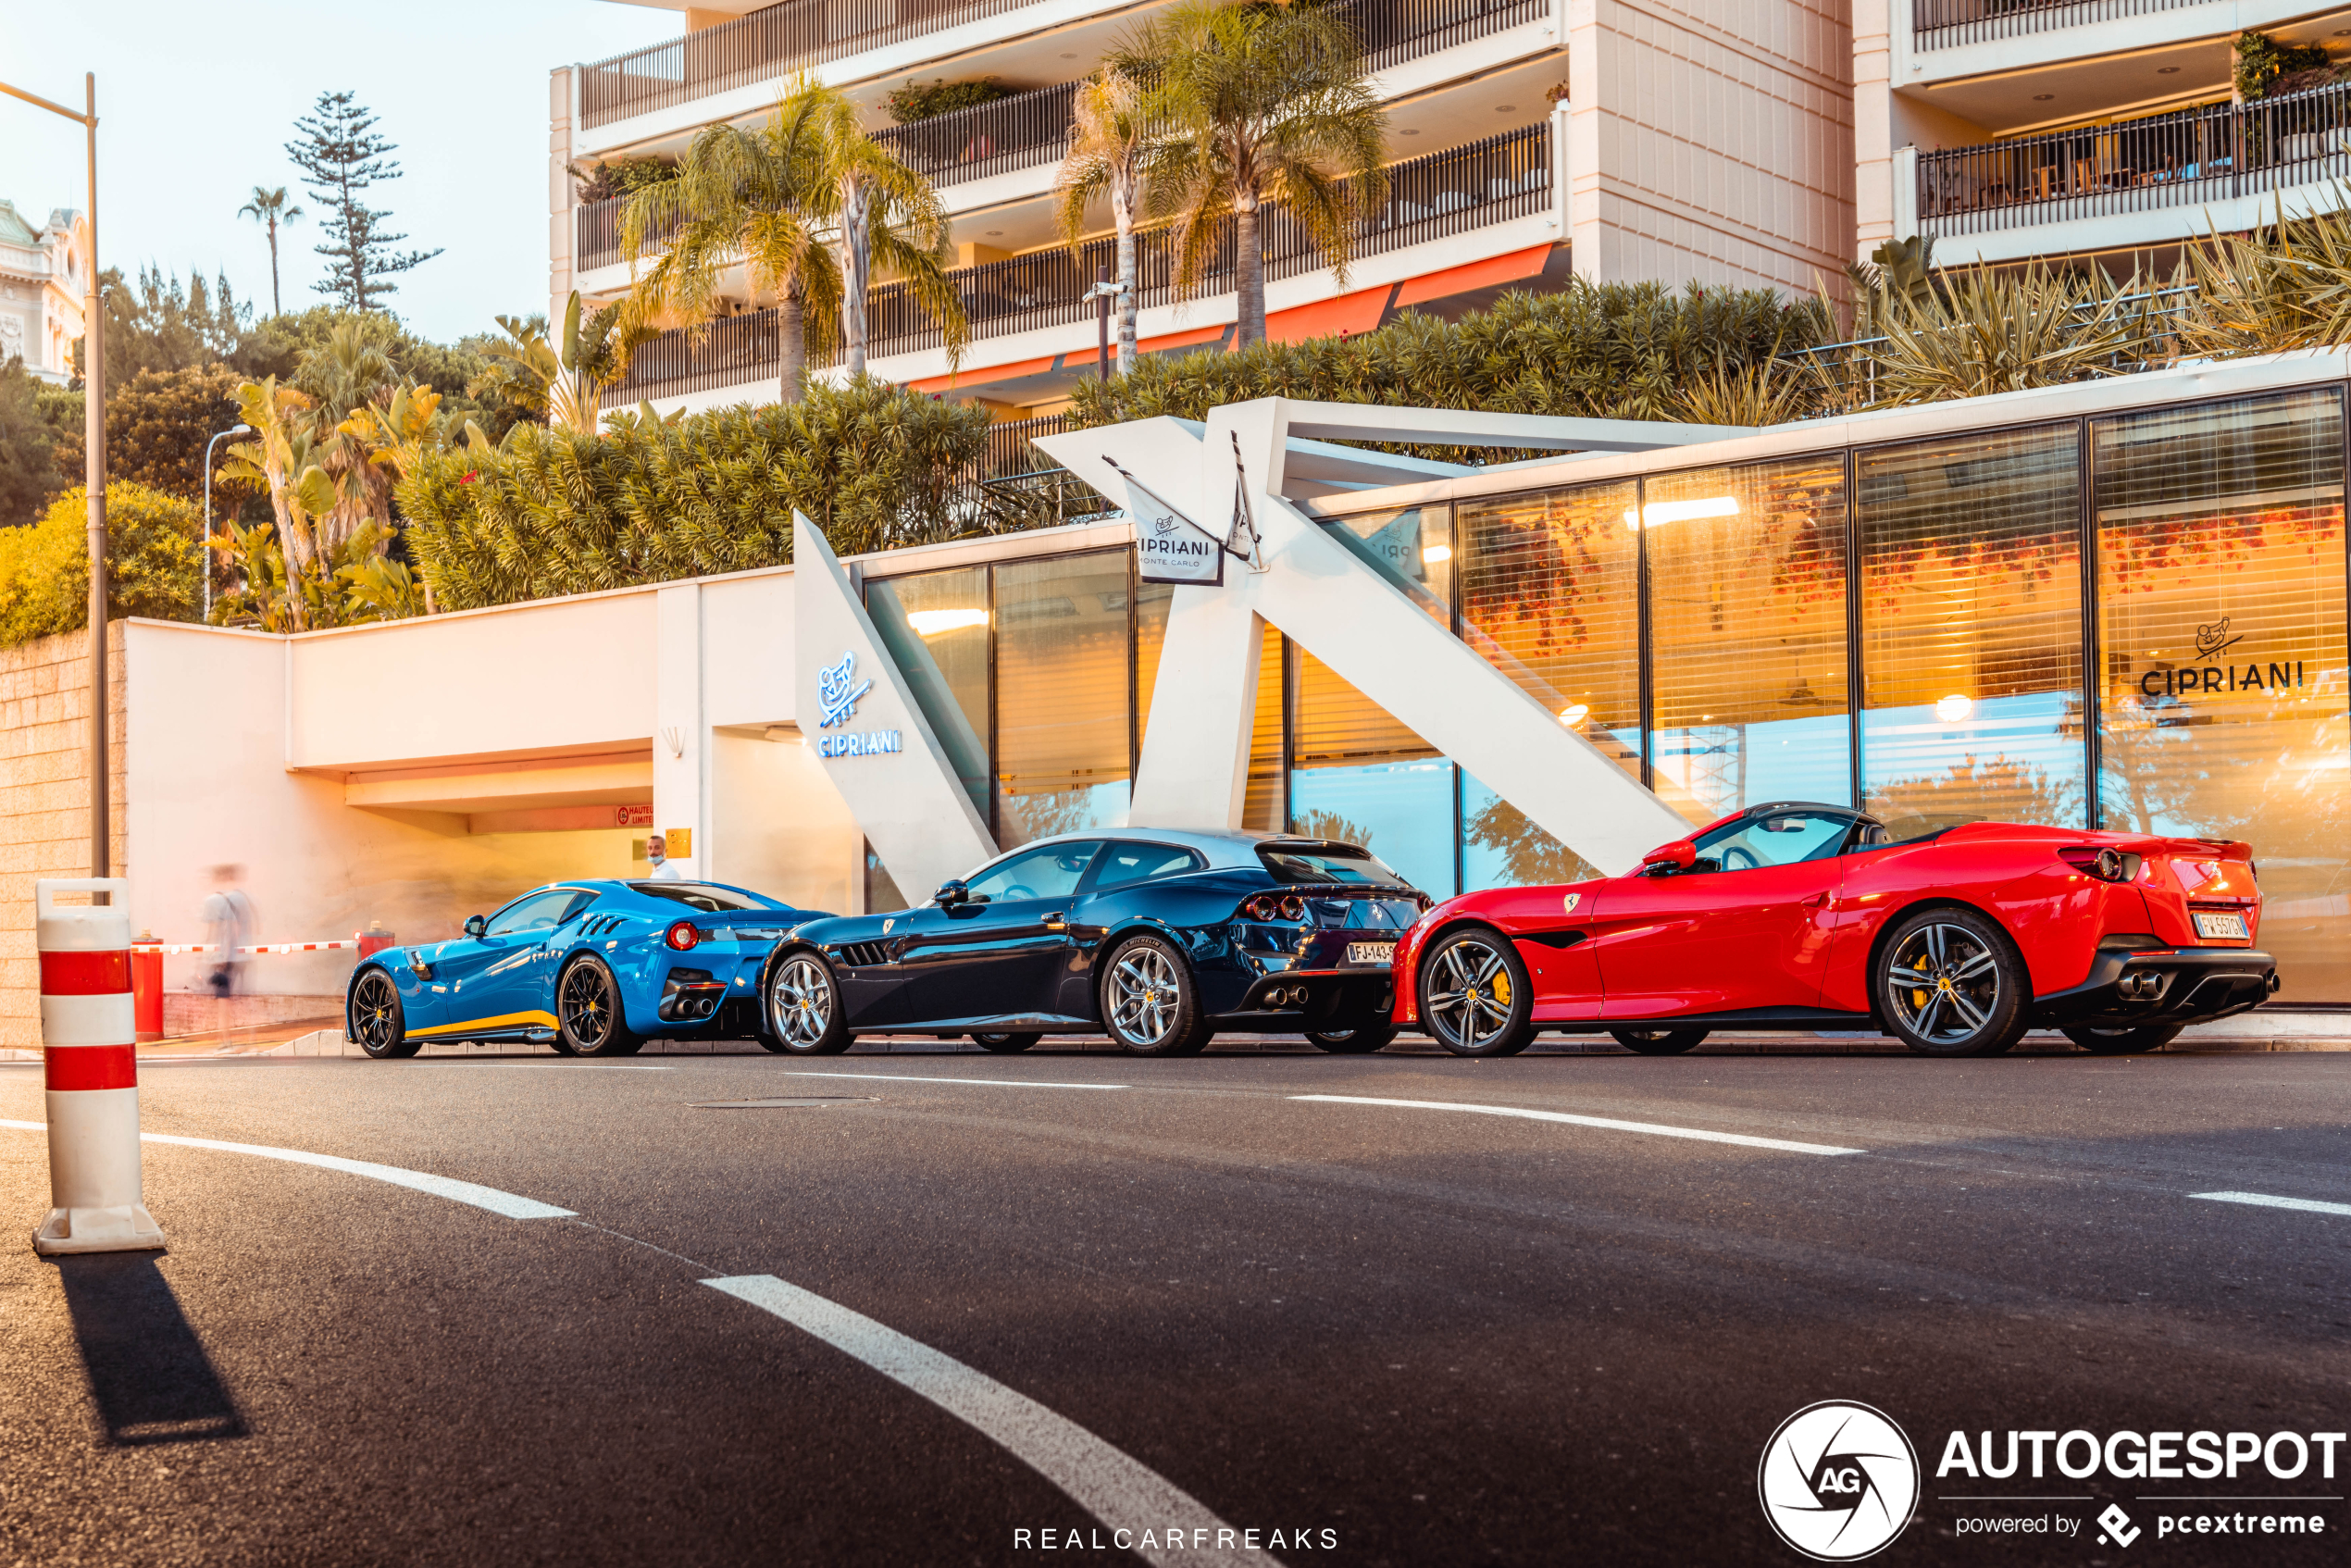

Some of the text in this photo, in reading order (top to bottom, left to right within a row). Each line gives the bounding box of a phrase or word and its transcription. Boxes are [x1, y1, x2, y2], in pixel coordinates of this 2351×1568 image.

[1137, 538, 1208, 555] IPRIANI
[1171, 559, 1200, 567] CARLO
[2141, 661, 2303, 697] CIPRIANI
[818, 729, 900, 757] CIPRIANI
[629, 806, 653, 815] HAUTEU
[632, 815, 653, 824] LIMITE
[1129, 938, 1161, 947] MICHELIN
